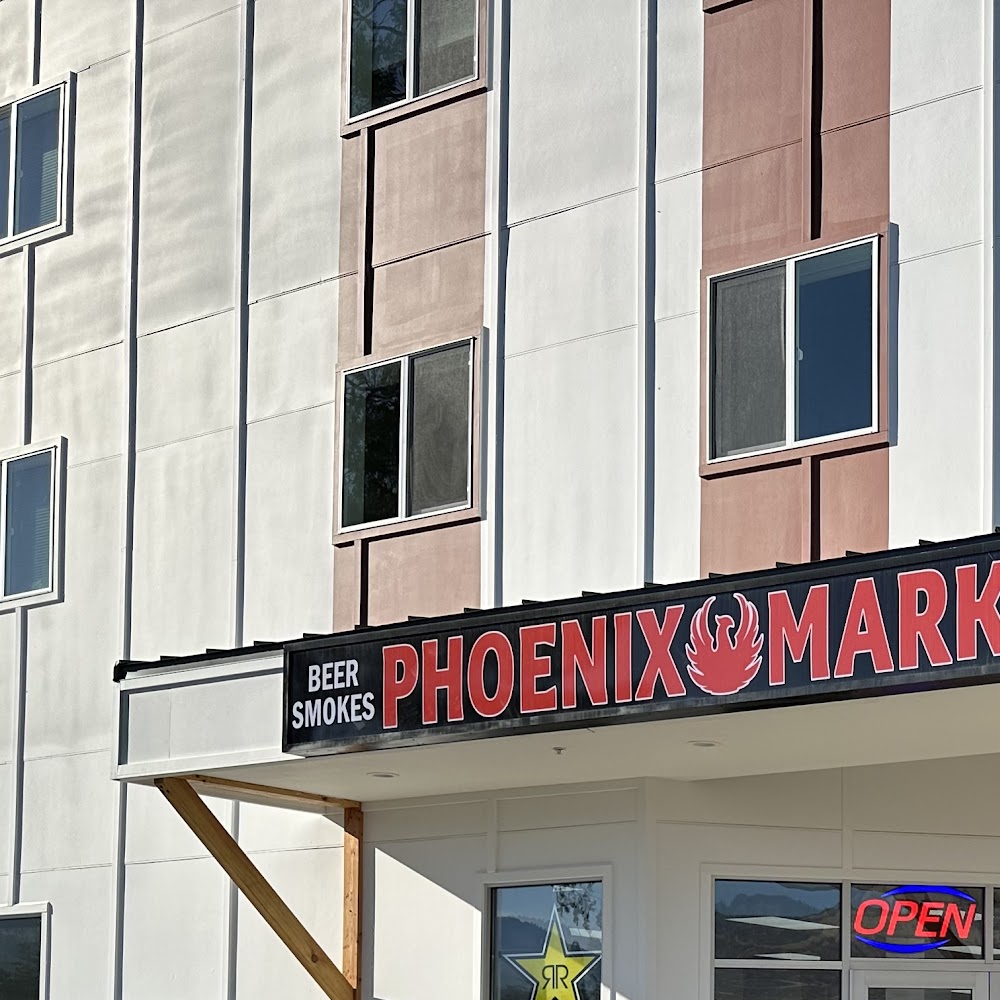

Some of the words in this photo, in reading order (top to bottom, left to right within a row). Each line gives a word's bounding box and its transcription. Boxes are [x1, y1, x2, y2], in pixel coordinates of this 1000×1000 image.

[308, 659, 359, 693] BEER
[382, 604, 686, 730] PHOENIX
[292, 692, 376, 730] SMOKES
[853, 898, 977, 939] OPEN
